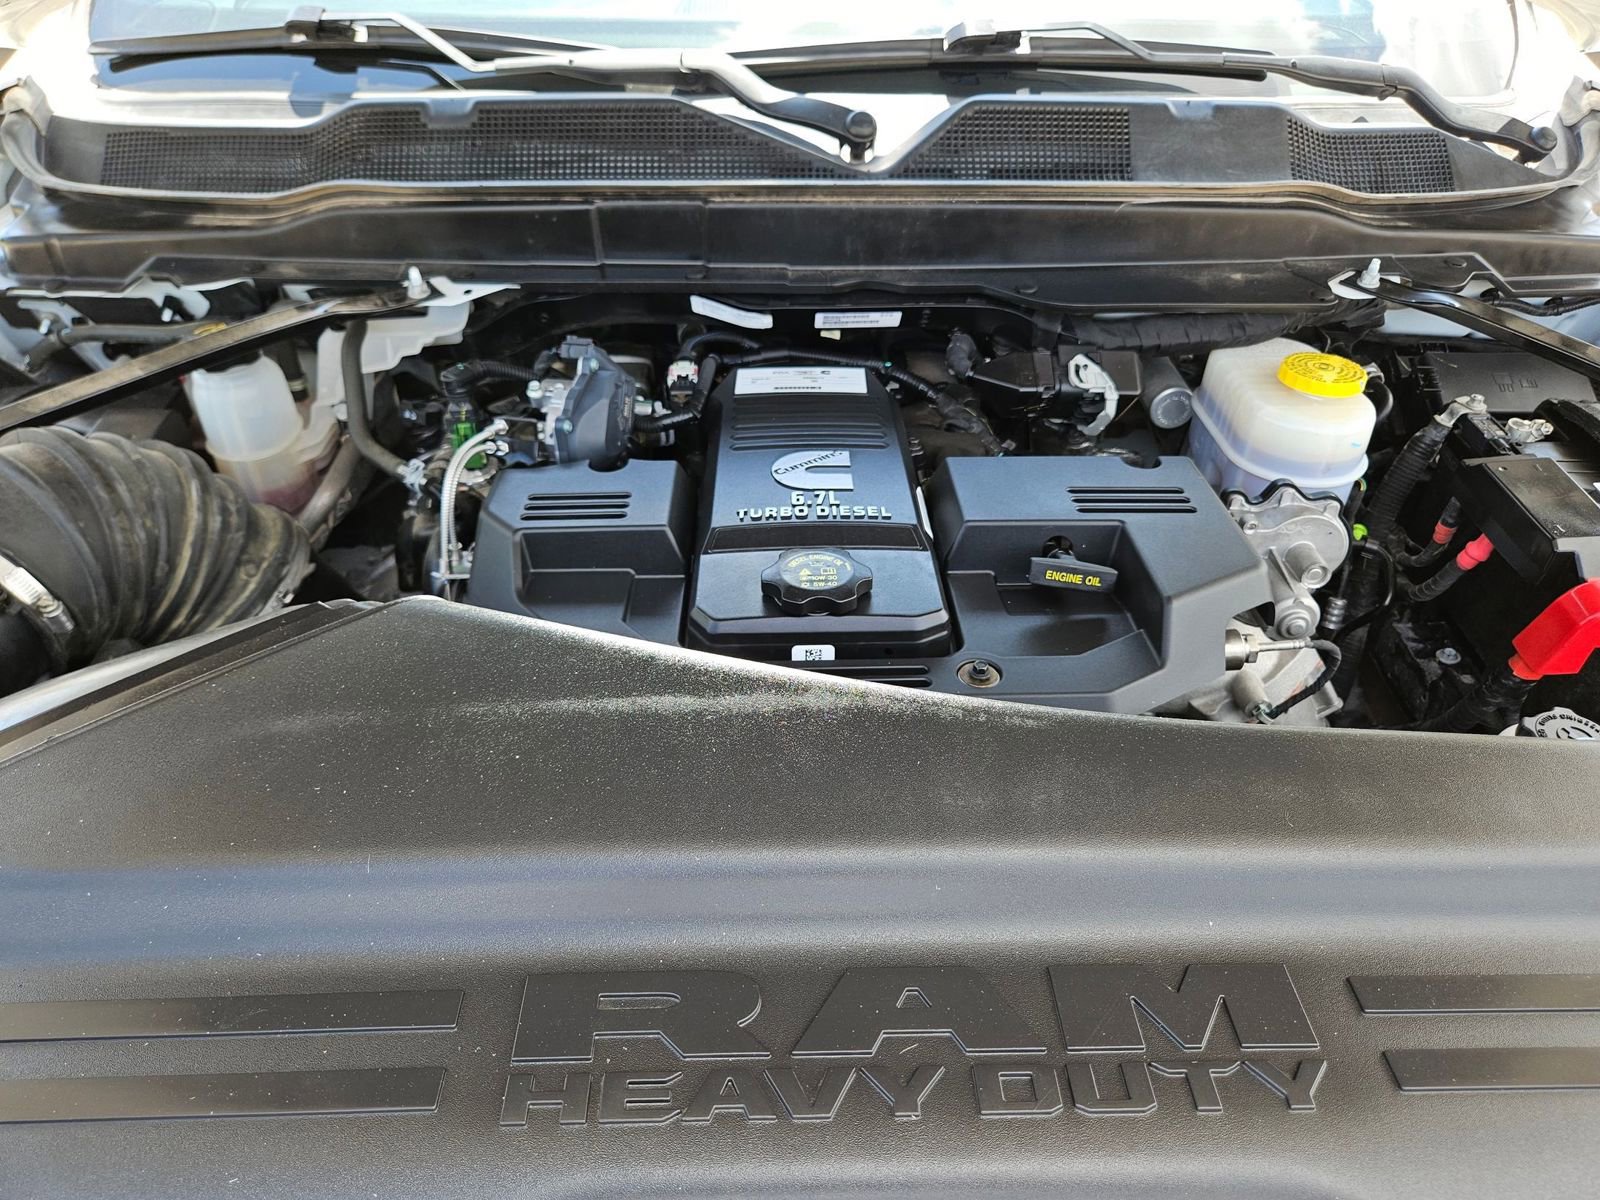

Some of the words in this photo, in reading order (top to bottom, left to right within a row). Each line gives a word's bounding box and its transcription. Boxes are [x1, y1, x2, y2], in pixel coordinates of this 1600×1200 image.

[773, 449, 843, 475] Cummins
[791, 490, 841, 507] 6.7L
[737, 507, 808, 521] TURBO
[816, 505, 892, 520] DIESEL
[1045, 570, 1084, 584] ENGINE
[1085, 575, 1102, 587] OIL
[511, 964, 1321, 1064] RAM
[499, 1064, 947, 1128] HEAVY
[972, 1060, 1328, 1119] DUTY
